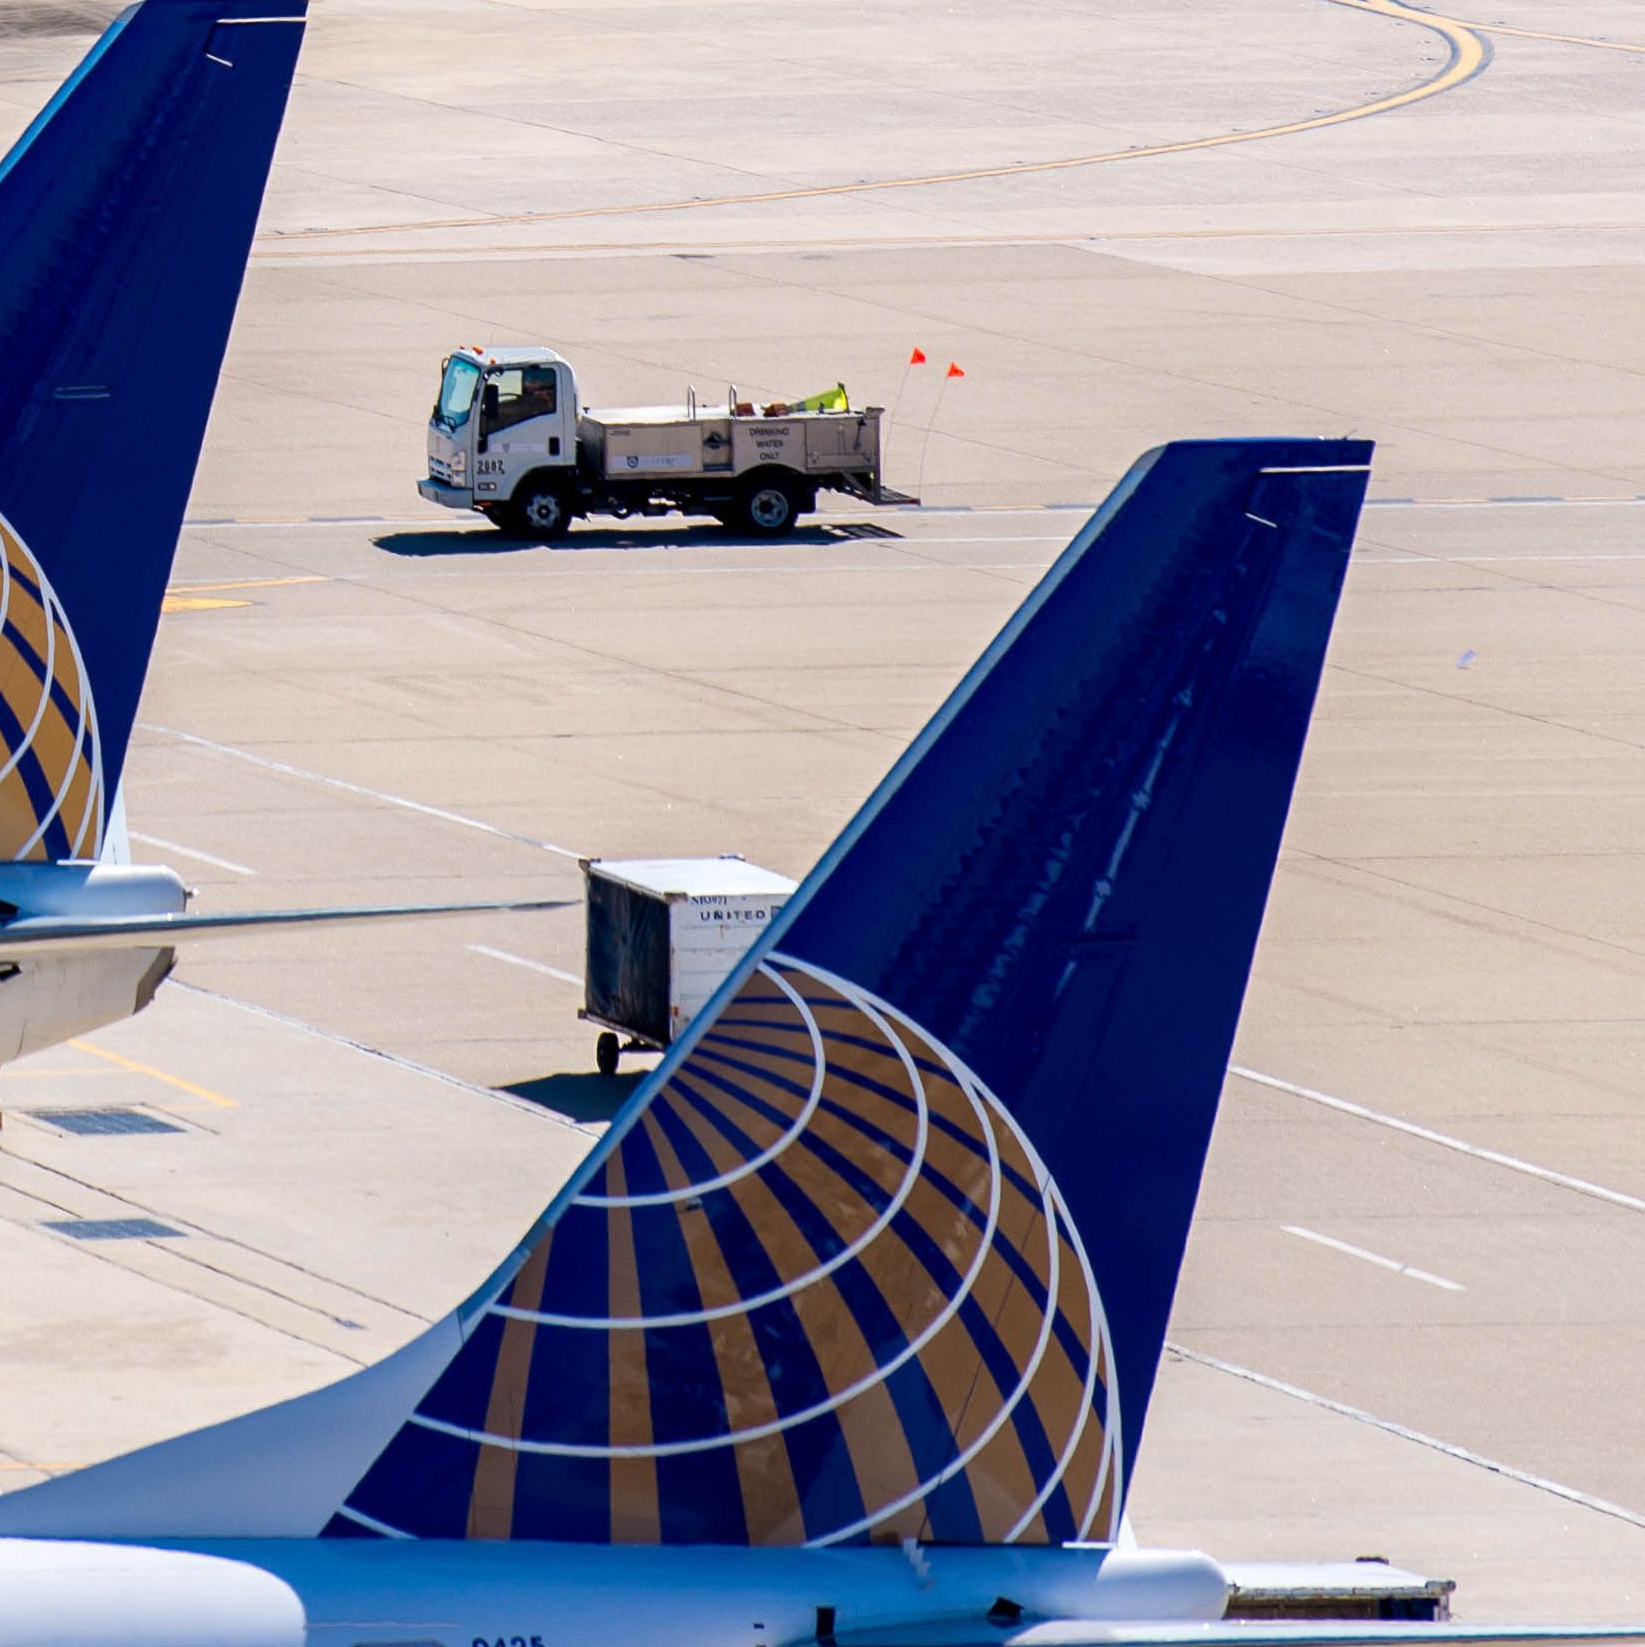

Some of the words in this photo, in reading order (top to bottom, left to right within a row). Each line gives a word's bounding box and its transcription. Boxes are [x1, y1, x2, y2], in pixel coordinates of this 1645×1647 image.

[755, 439, 784, 448] WATER
[759, 452, 780, 461] ONLY
[699, 910, 766, 922] UNITED
